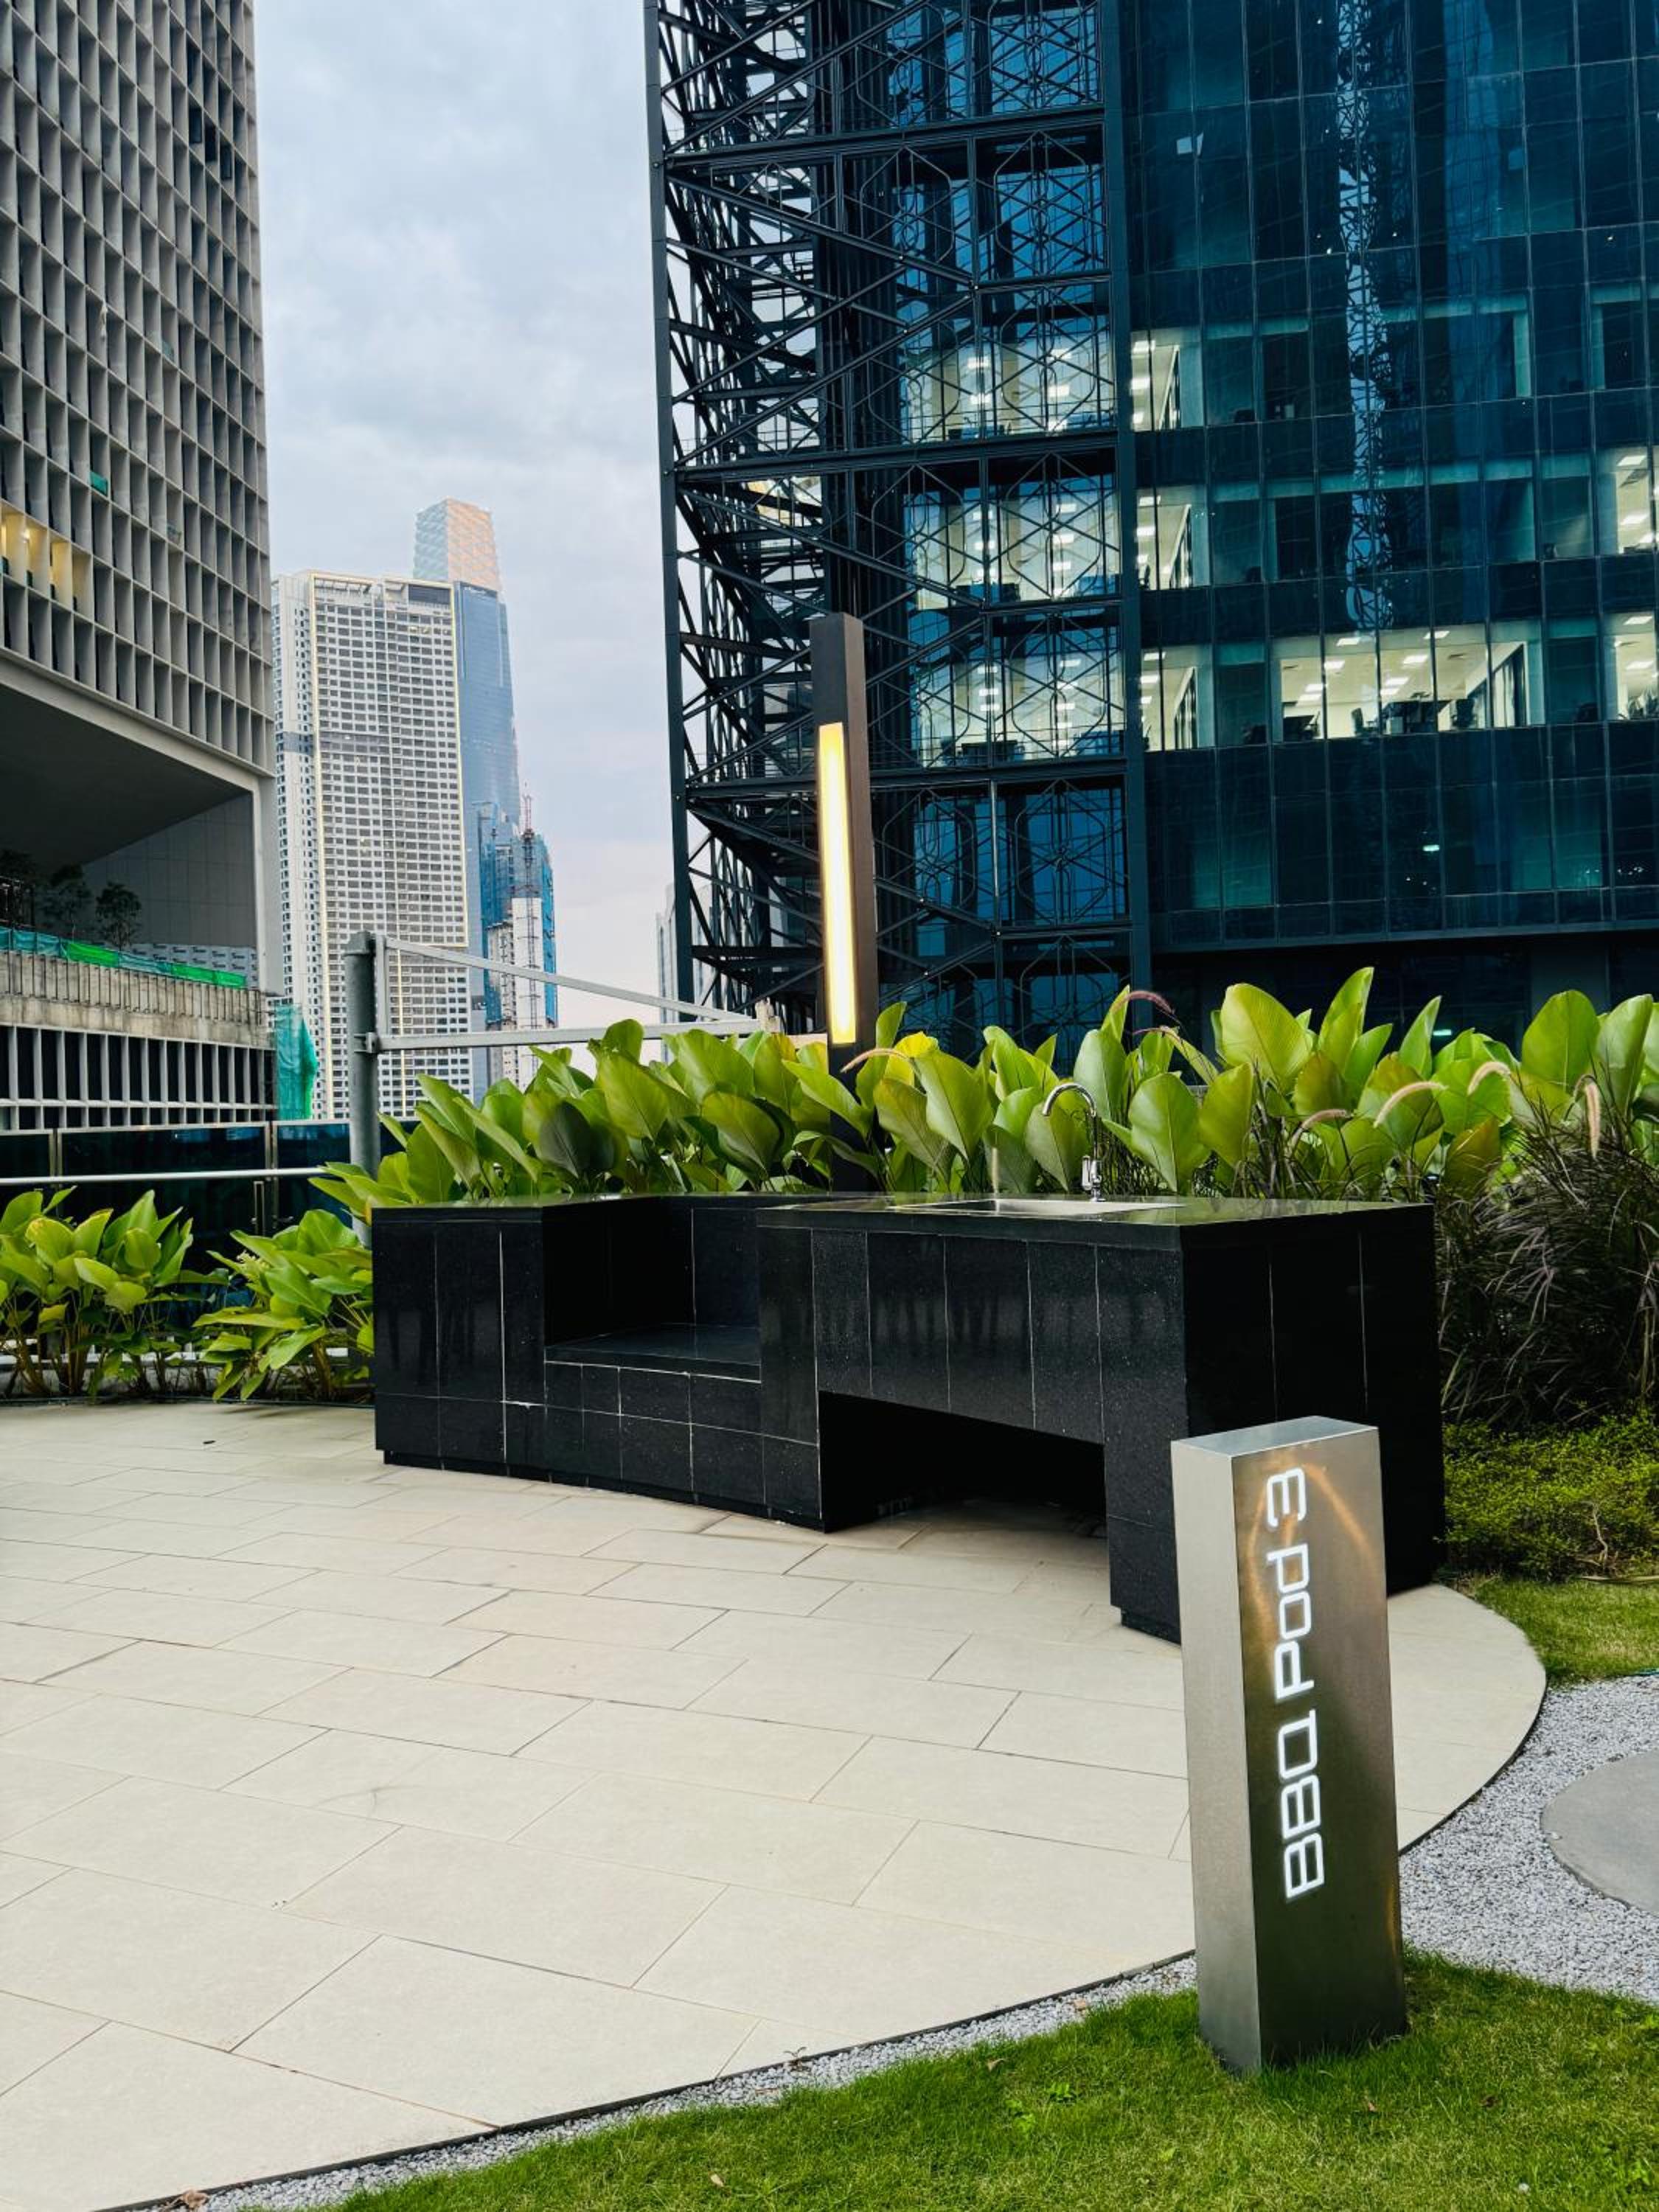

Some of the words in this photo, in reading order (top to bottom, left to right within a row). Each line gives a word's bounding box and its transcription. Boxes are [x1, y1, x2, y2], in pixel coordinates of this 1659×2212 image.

[1265, 1467, 1307, 1528] 3
[1266, 1543, 1315, 1703] Pod
[1277, 1708, 1324, 1902] BBQ
